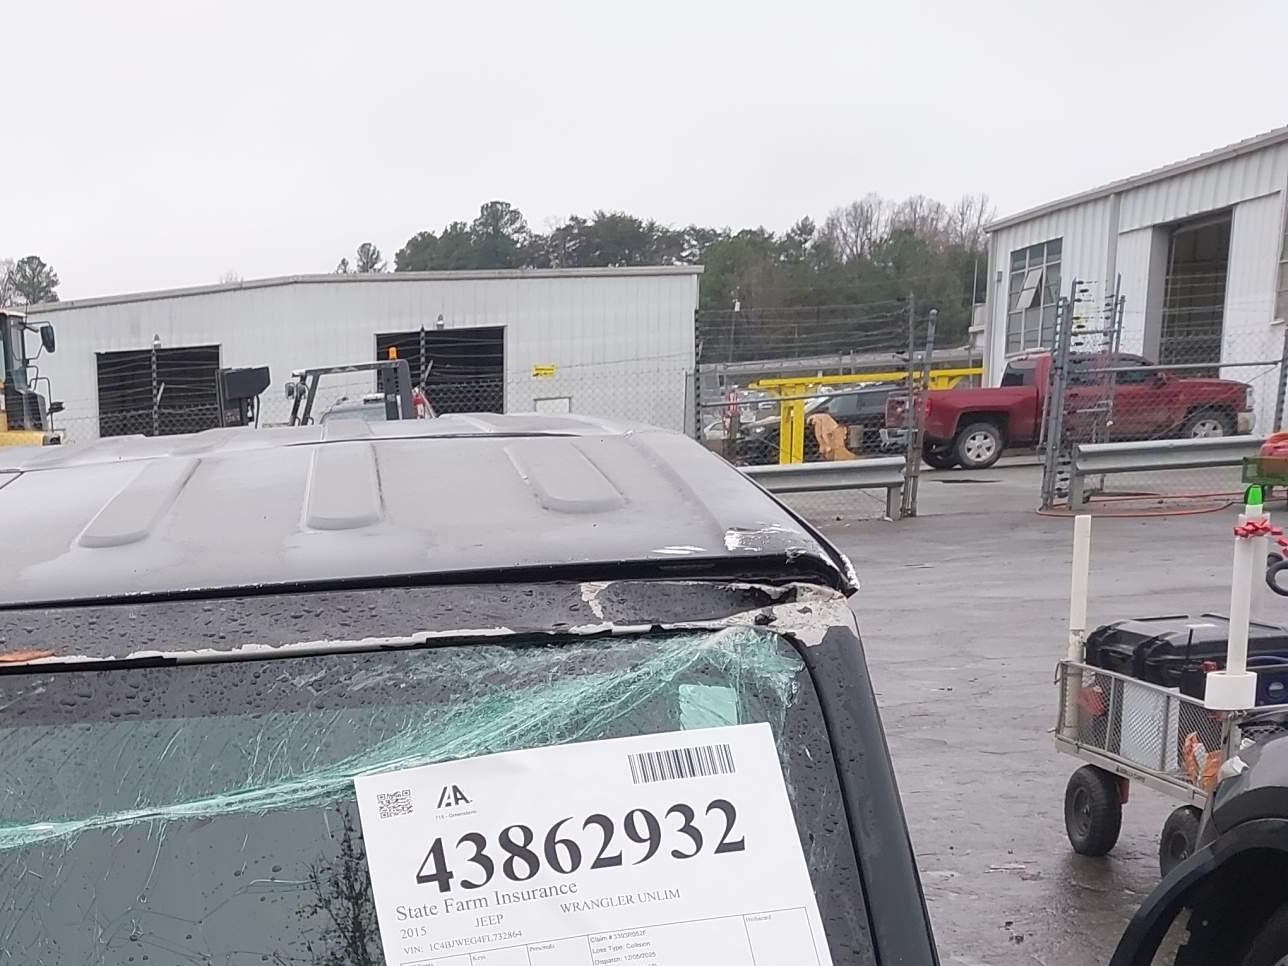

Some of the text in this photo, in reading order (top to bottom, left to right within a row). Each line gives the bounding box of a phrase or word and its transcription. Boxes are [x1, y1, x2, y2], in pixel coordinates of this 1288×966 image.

[415, 798, 746, 893] 43862932
[396, 882, 578, 921] State Farm Insurance
[401, 888, 681, 939] 2015 JEEP WRANGLER UNLIM
[403, 930, 522, 955] VIN: 1C4BJWEG4FL732864
[590, 935, 608, 943] Claim
[592, 941, 651, 954] Loss Type: Collision
[594, 956, 623, 966] Dispatch:
